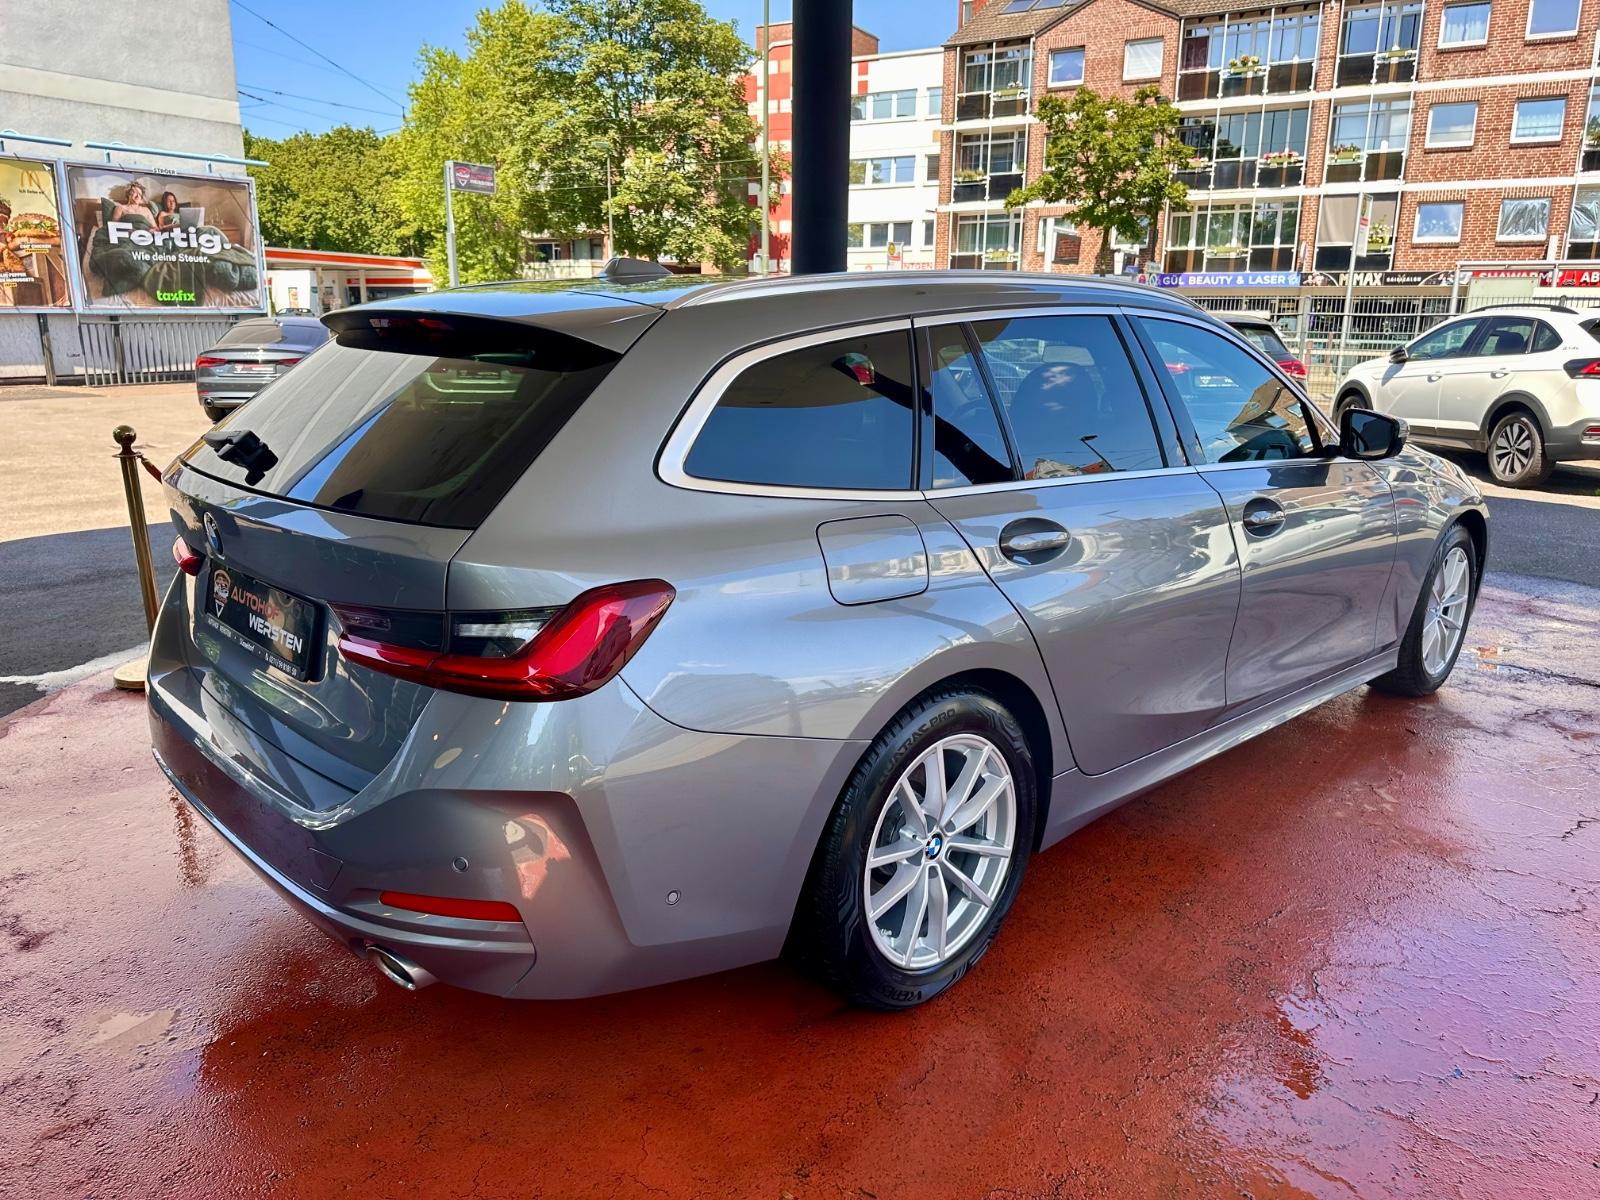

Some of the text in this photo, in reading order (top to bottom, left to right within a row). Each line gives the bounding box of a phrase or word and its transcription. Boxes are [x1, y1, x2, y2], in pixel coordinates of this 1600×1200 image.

[107, 221, 232, 255] Fortig.
[132, 251, 211, 263] Wie deine Steuer.
[1162, 274, 1286, 285] GÜL BEAUTY & LASER
[1338, 272, 1383, 286] MMAX
[156, 290, 195, 301] taxfix
[231, 586, 282, 620] AUTOHOF
[249, 612, 303, 654] WERSTEN
[928, 708, 956, 728] PRO
